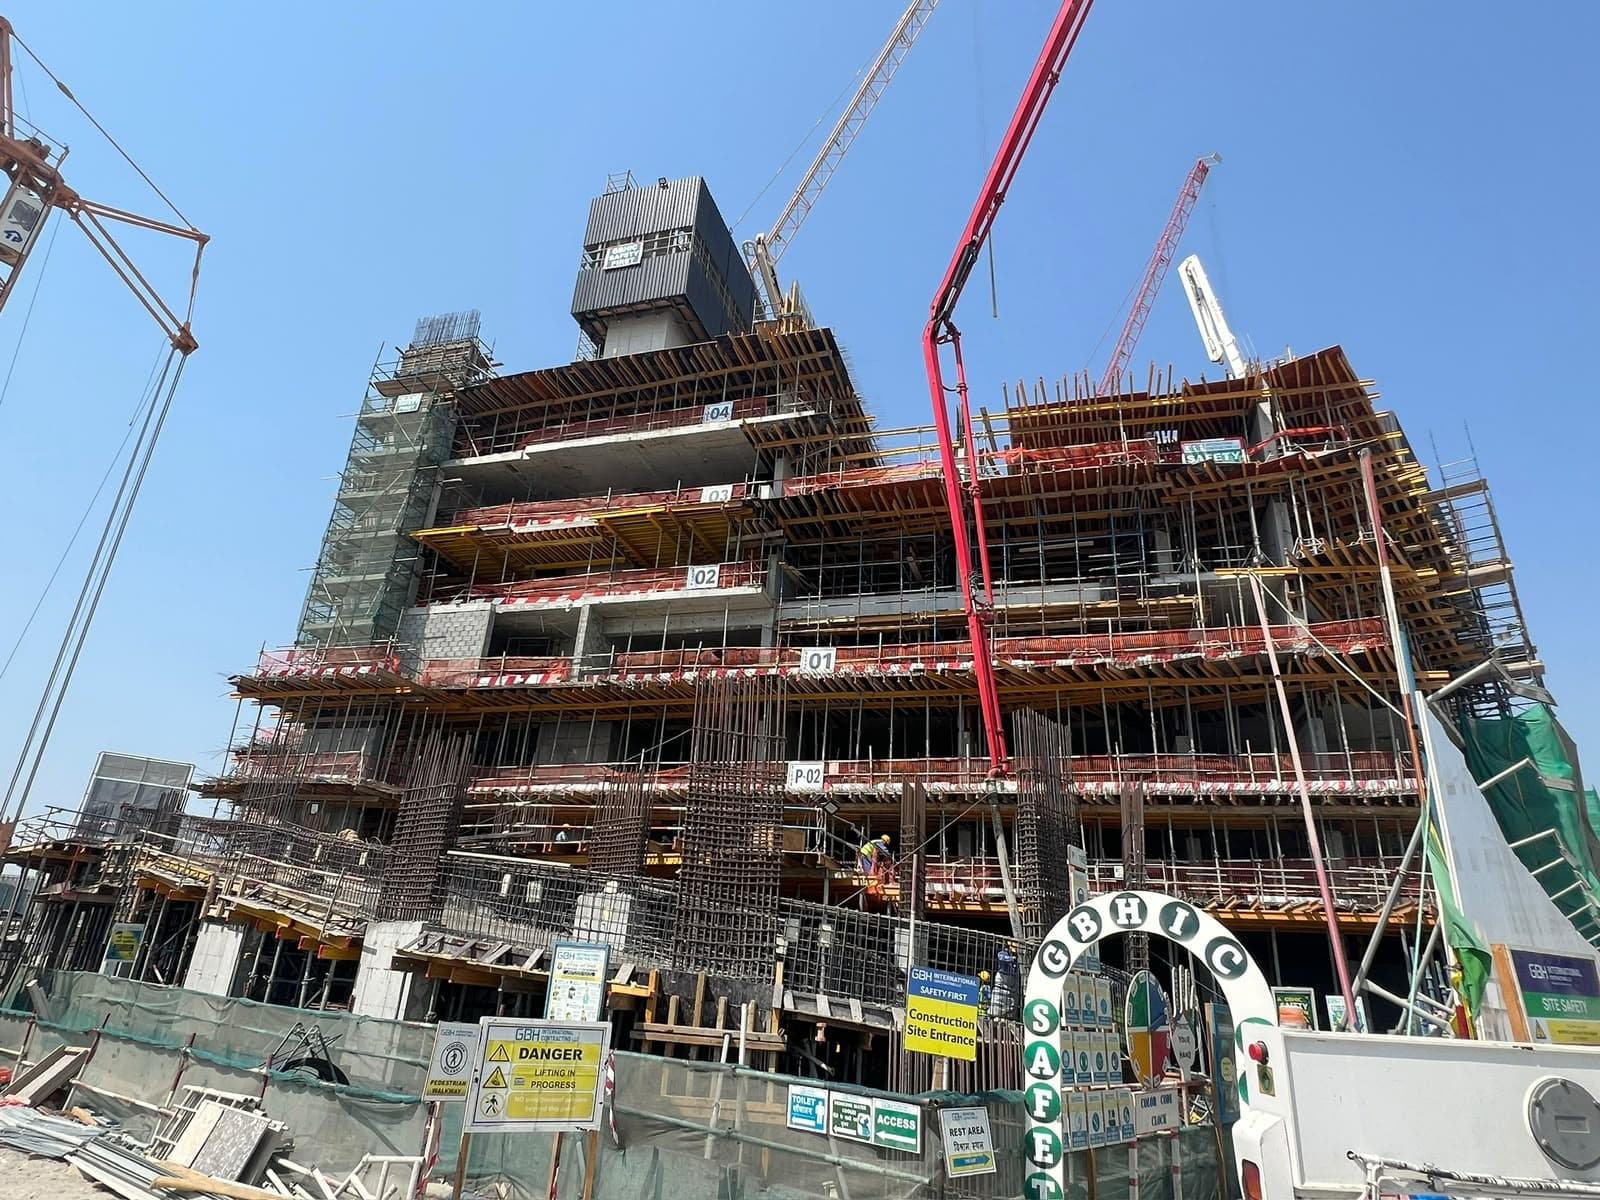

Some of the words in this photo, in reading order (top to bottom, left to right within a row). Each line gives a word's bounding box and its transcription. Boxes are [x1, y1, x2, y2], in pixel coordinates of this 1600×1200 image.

[710, 406, 729, 420] 04
[1185, 451, 1241, 464] SAFETY
[709, 489, 729, 501] 03
[695, 569, 716, 585] 02
[809, 653, 832, 669] 01
[795, 768, 821, 784] P-02
[911, 968, 933, 982] GBH
[934, 973, 977, 986] INTERNATIONAL
[920, 985, 947, 998] SAFETY
[947, 990, 968, 1001] FIRST
[1542, 998, 1561, 1011] SITE
[1561, 999, 1588, 1015] SAFETY
[909, 1008, 975, 1030] Construction
[515, 1028, 540, 1041] GBH
[907, 1024, 927, 1038] Site
[930, 1028, 975, 1046] Entrance
[518, 1047, 582, 1061] DANGER
[534, 1068, 566, 1077] LIFTING
[429, 1079, 467, 1087] PEDESTRIAN
[530, 1080, 577, 1090] PROGRESS
[431, 1087, 462, 1095] WALKWAY
[792, 1095, 816, 1106] TOILET
[877, 1114, 916, 1129] ACCESS
[949, 1128, 966, 1137] REST
[967, 1126, 985, 1135] AREA
